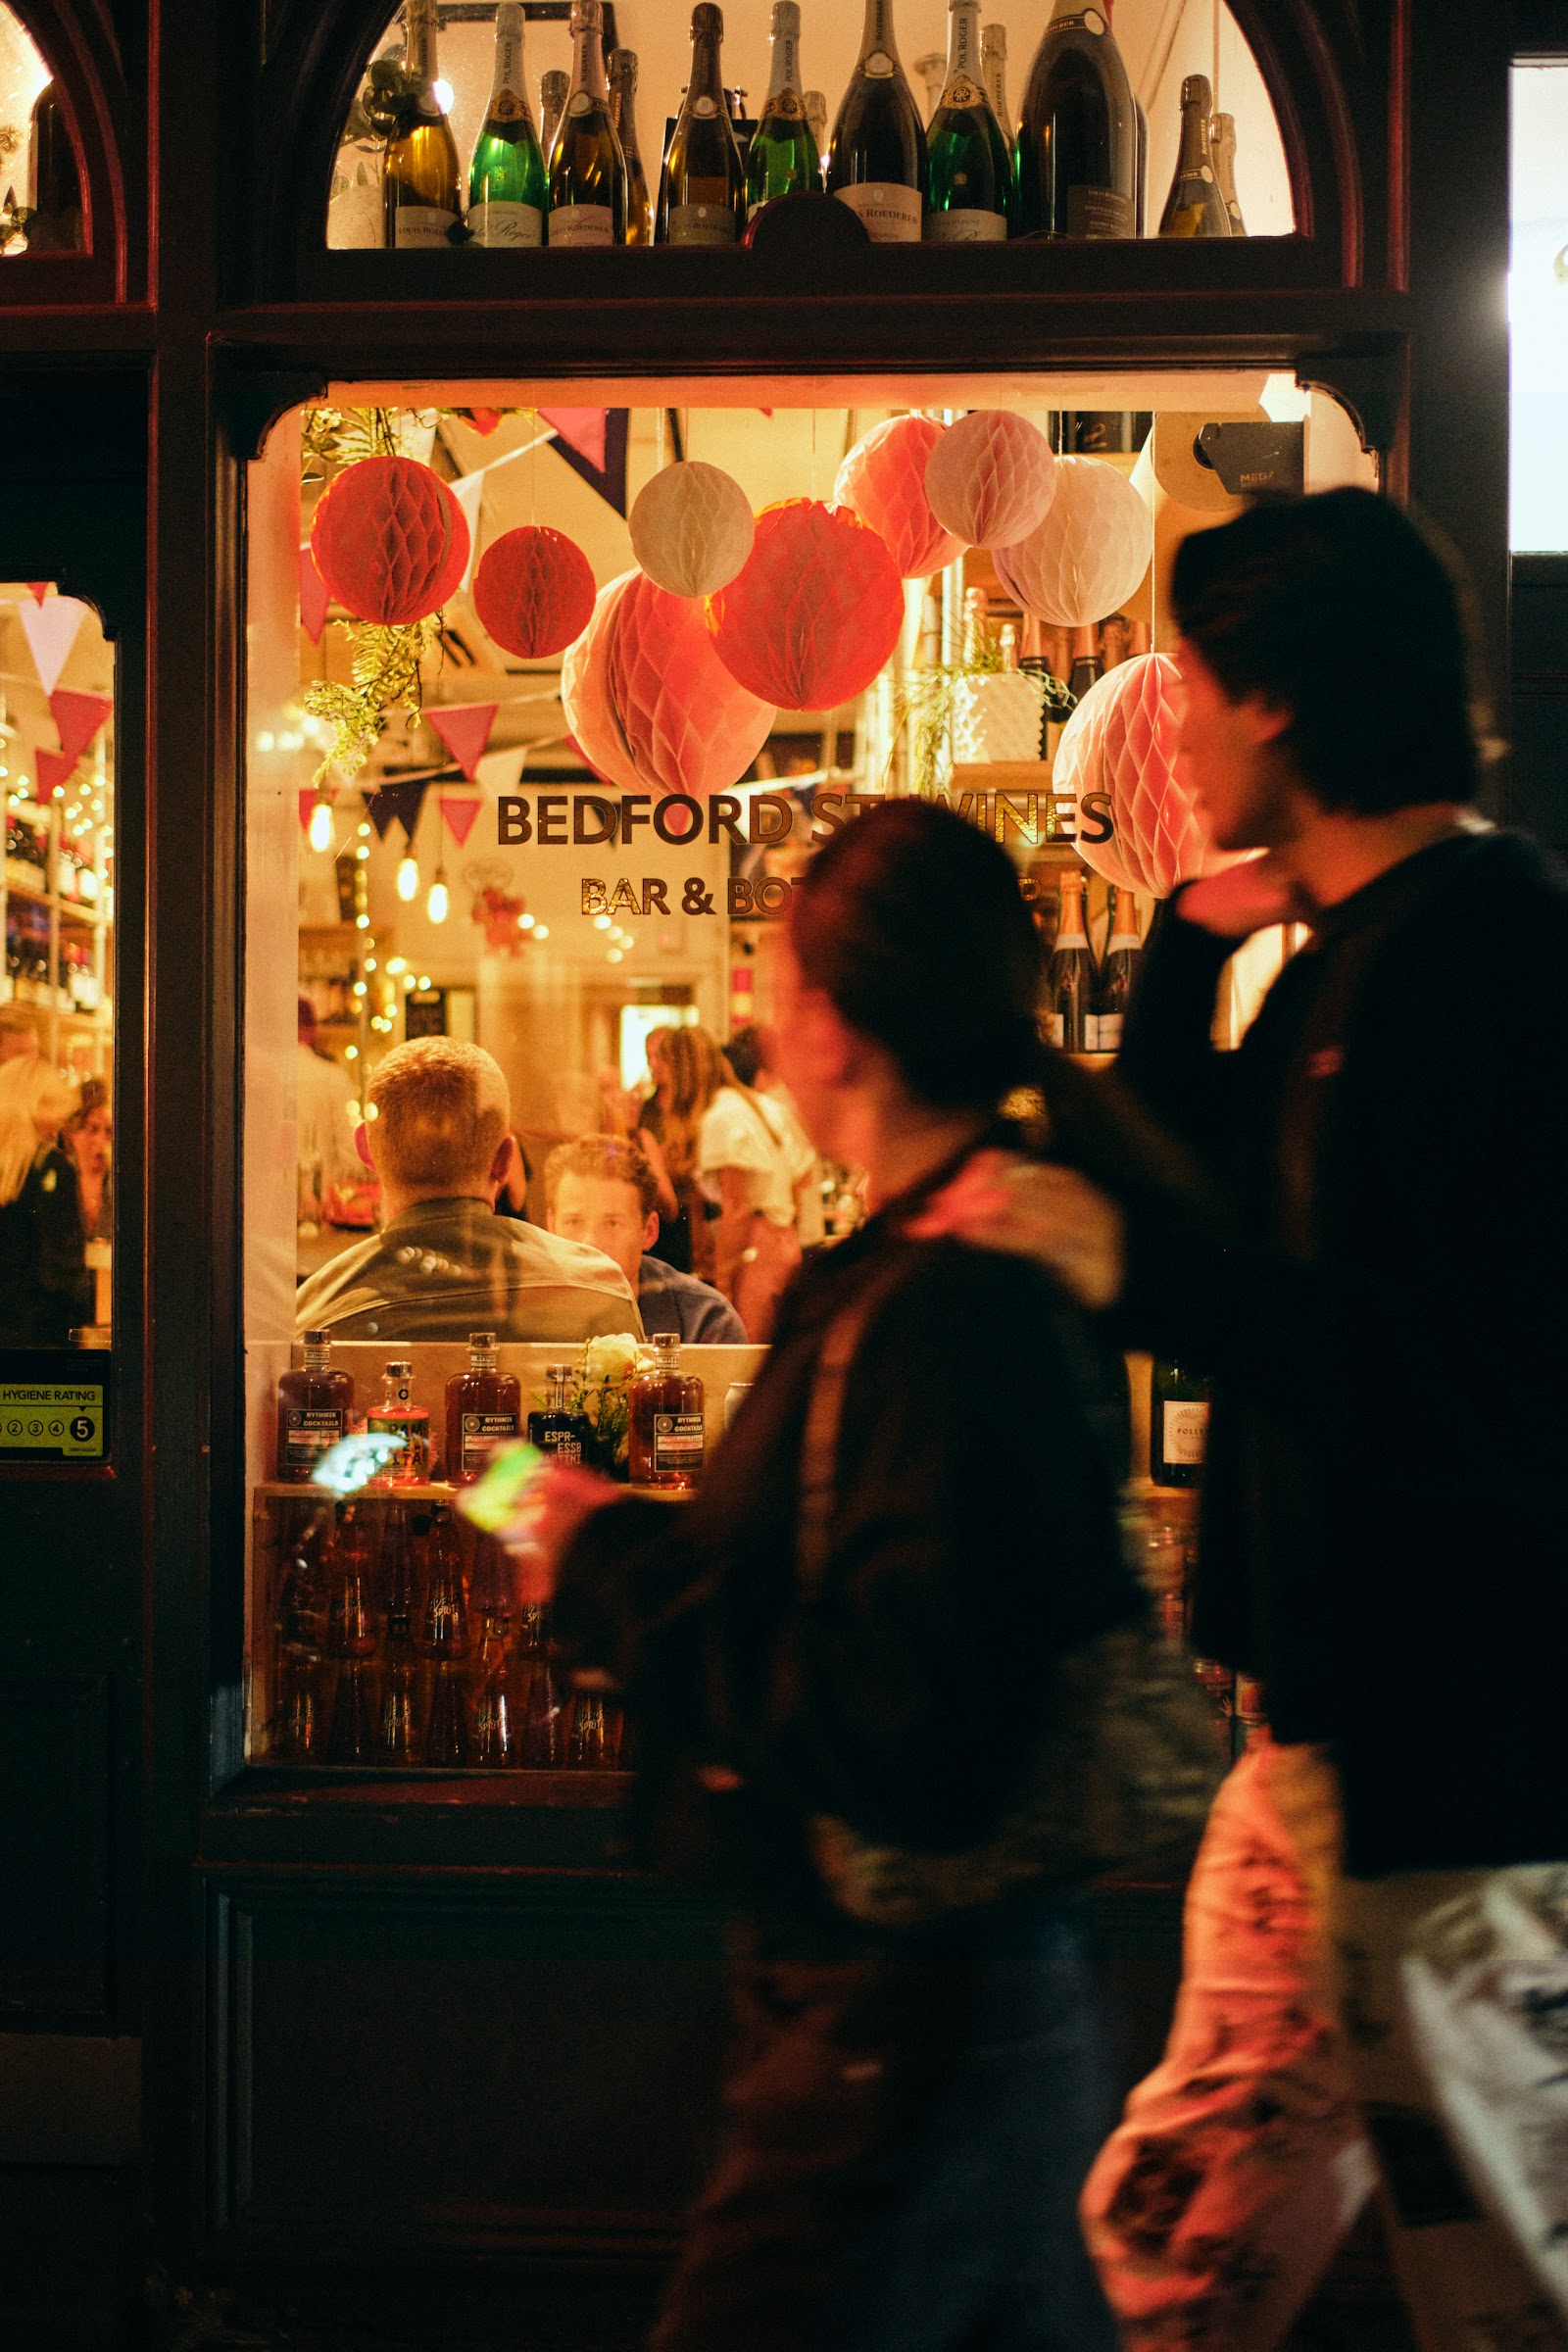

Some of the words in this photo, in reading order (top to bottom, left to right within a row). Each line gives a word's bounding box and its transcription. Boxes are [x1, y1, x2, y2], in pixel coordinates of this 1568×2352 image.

[866, 209, 917, 224] ROEDERER
[497, 795, 794, 846] BEDFORD
[580, 876, 671, 915] BAR
[680, 876, 717, 915] &
[3, 1390, 52, 1400] HYGIENE
[54, 1390, 96, 1400] RATING
[76, 1419, 89, 1439] 5
